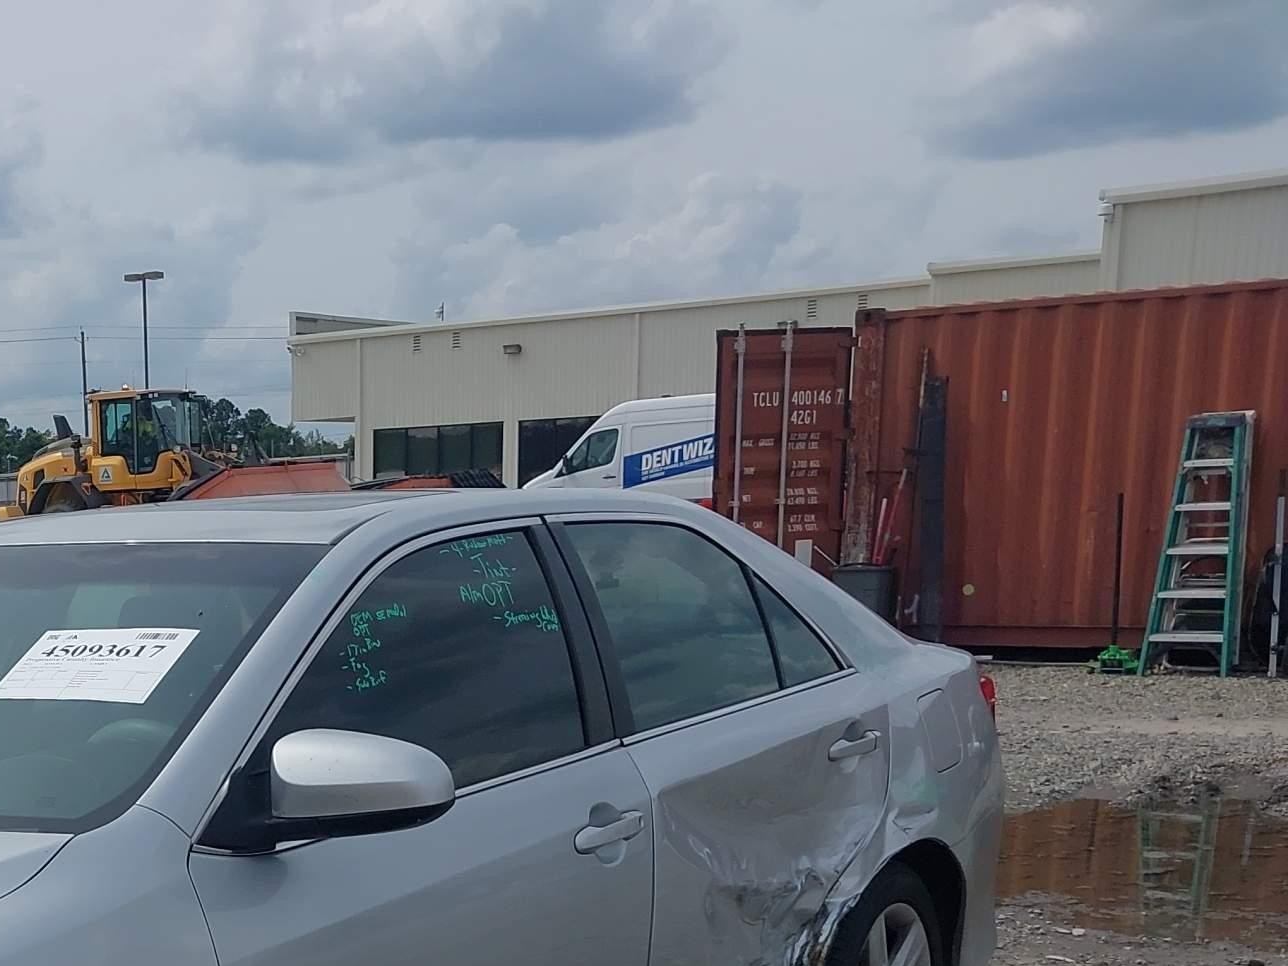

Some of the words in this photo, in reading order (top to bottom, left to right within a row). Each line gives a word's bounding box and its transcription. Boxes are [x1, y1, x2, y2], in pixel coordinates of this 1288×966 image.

[753, 391, 780, 407] TCLU
[792, 390, 832, 406] 400146
[790, 410, 817, 425] 42G1
[41, 644, 168, 658] 45093617
